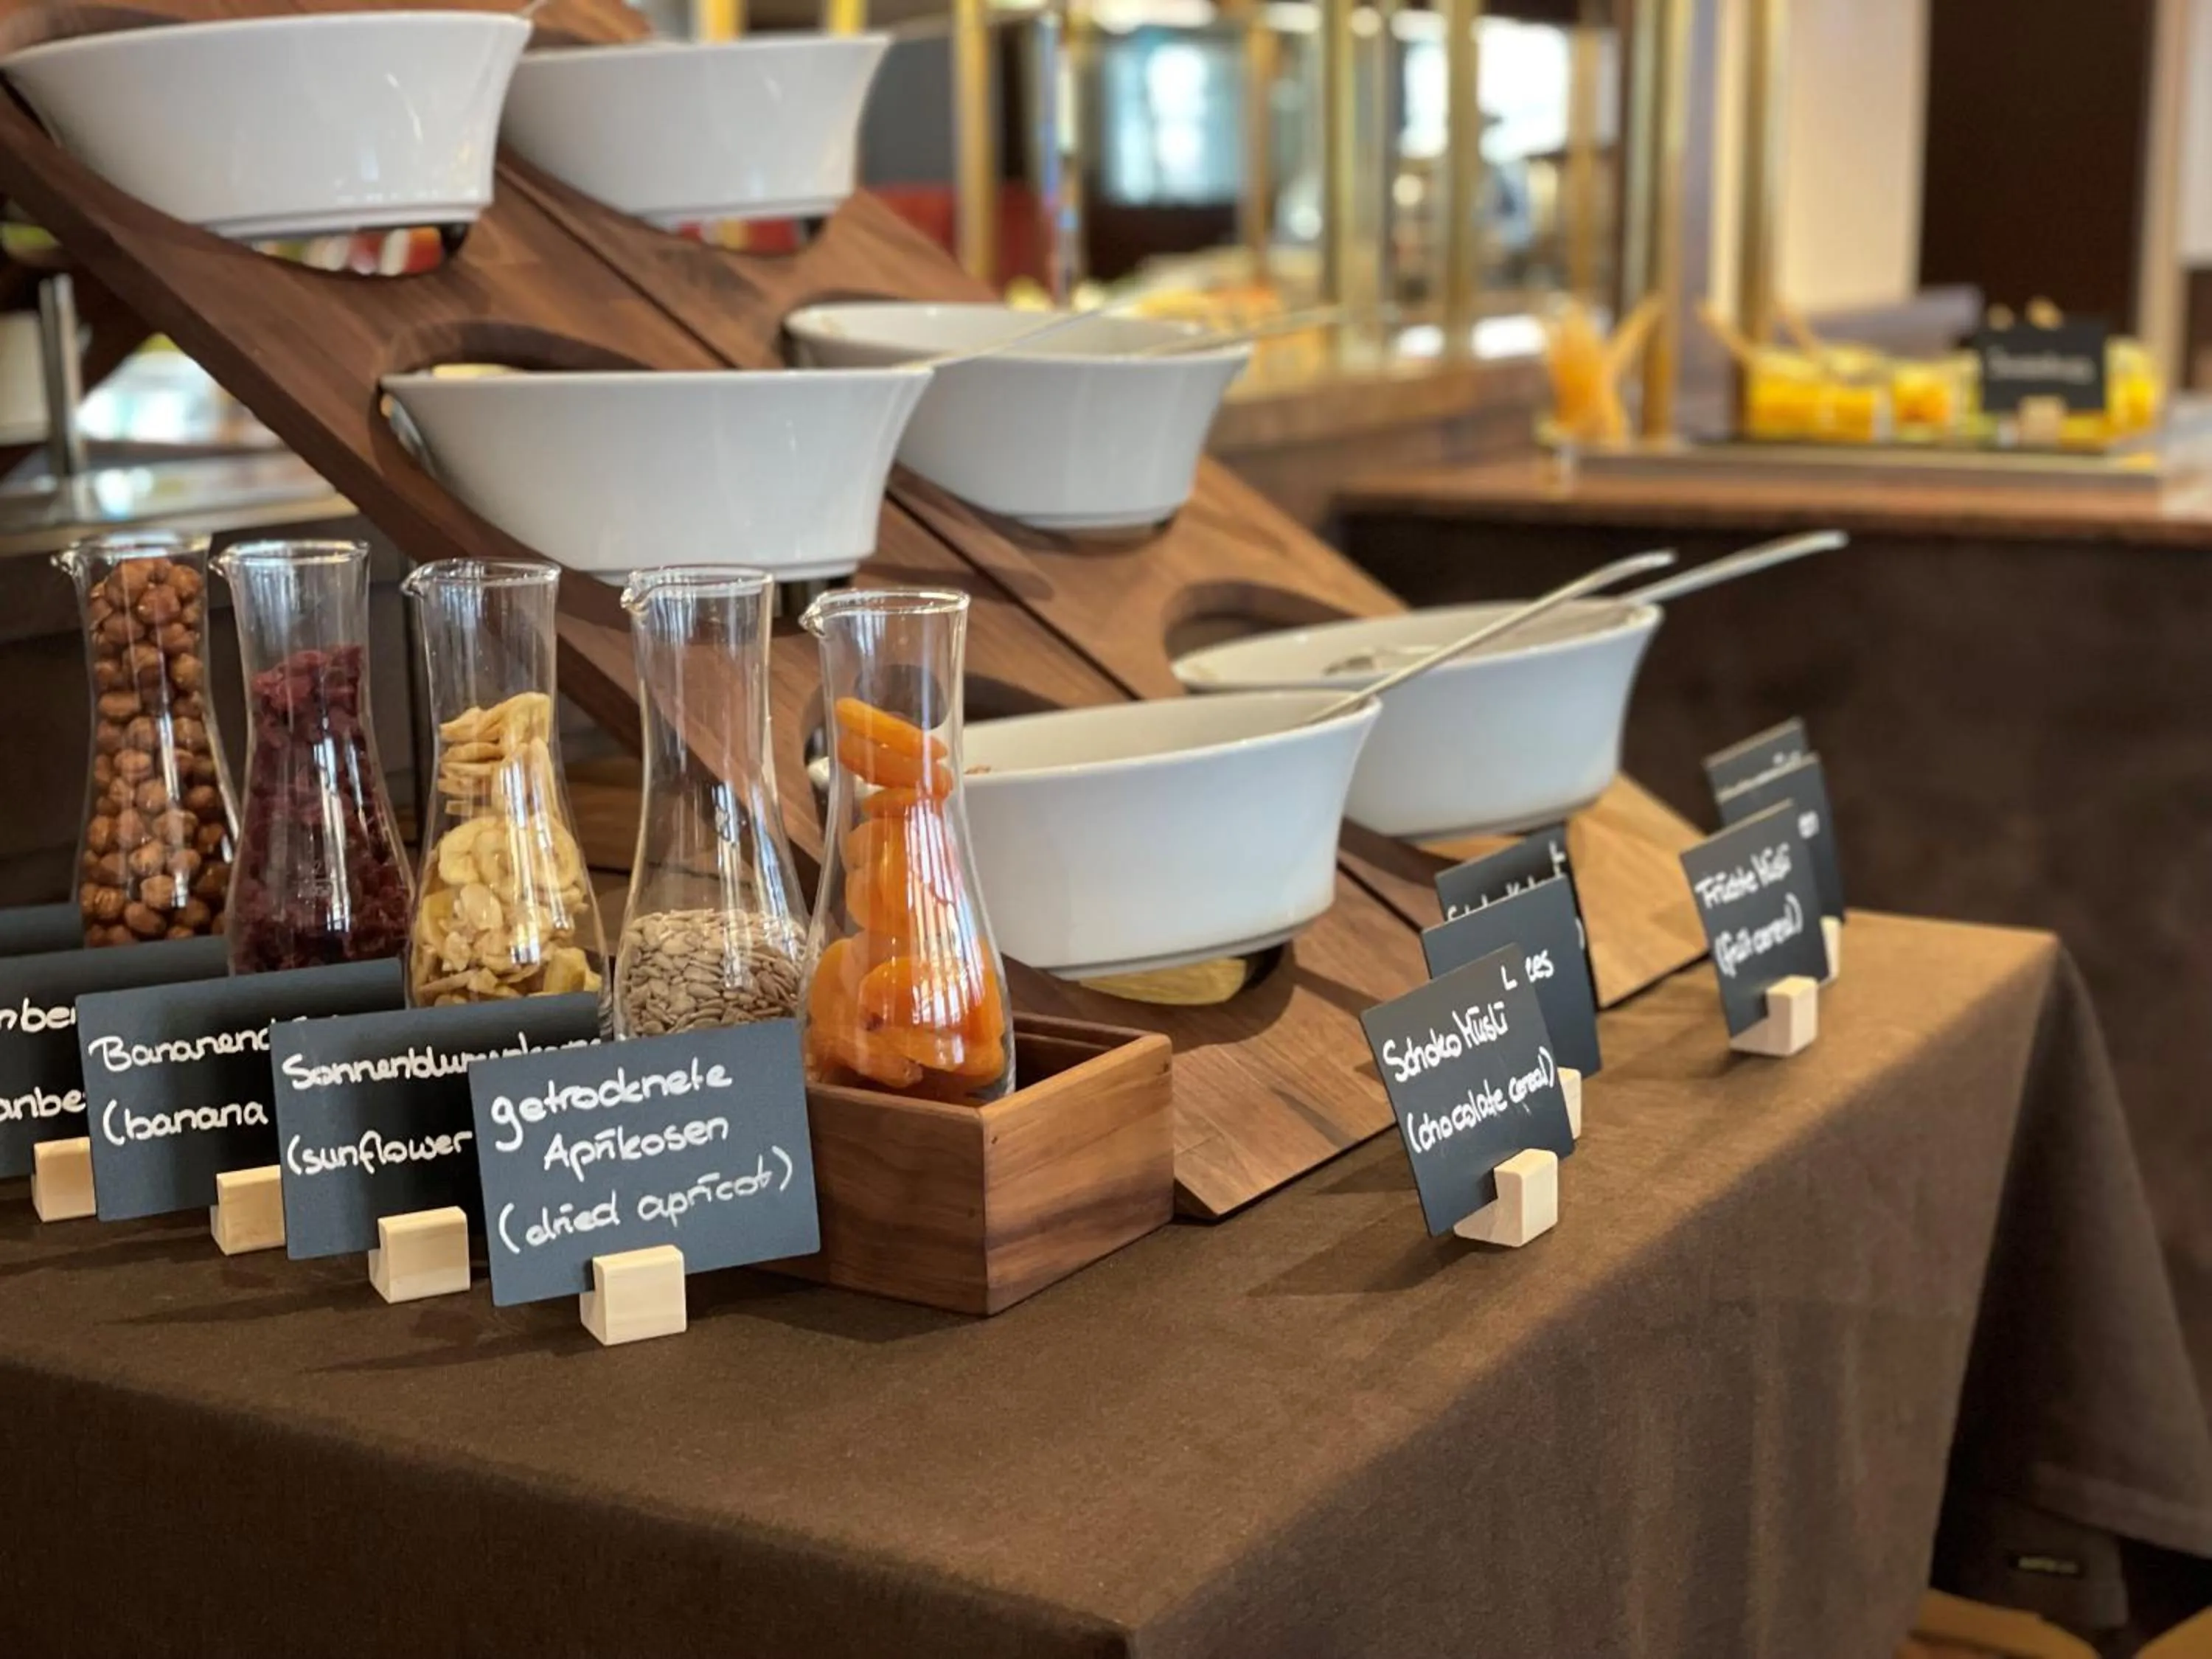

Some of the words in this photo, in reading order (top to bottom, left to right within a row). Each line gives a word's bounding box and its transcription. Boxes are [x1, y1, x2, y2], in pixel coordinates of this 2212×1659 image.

[1382, 1027, 1462, 1082] Schoko
[102, 1099, 268, 1146] (banana
[490, 1057, 733, 1152] getrocknete
[1408, 1079, 1508, 1154] (chocolate
[287, 1130, 473, 1175] (sunflower
[543, 1116, 729, 1182] Aprikosen
[498, 1189, 621, 1254] (dried
[637, 1145, 793, 1228] apricot)
